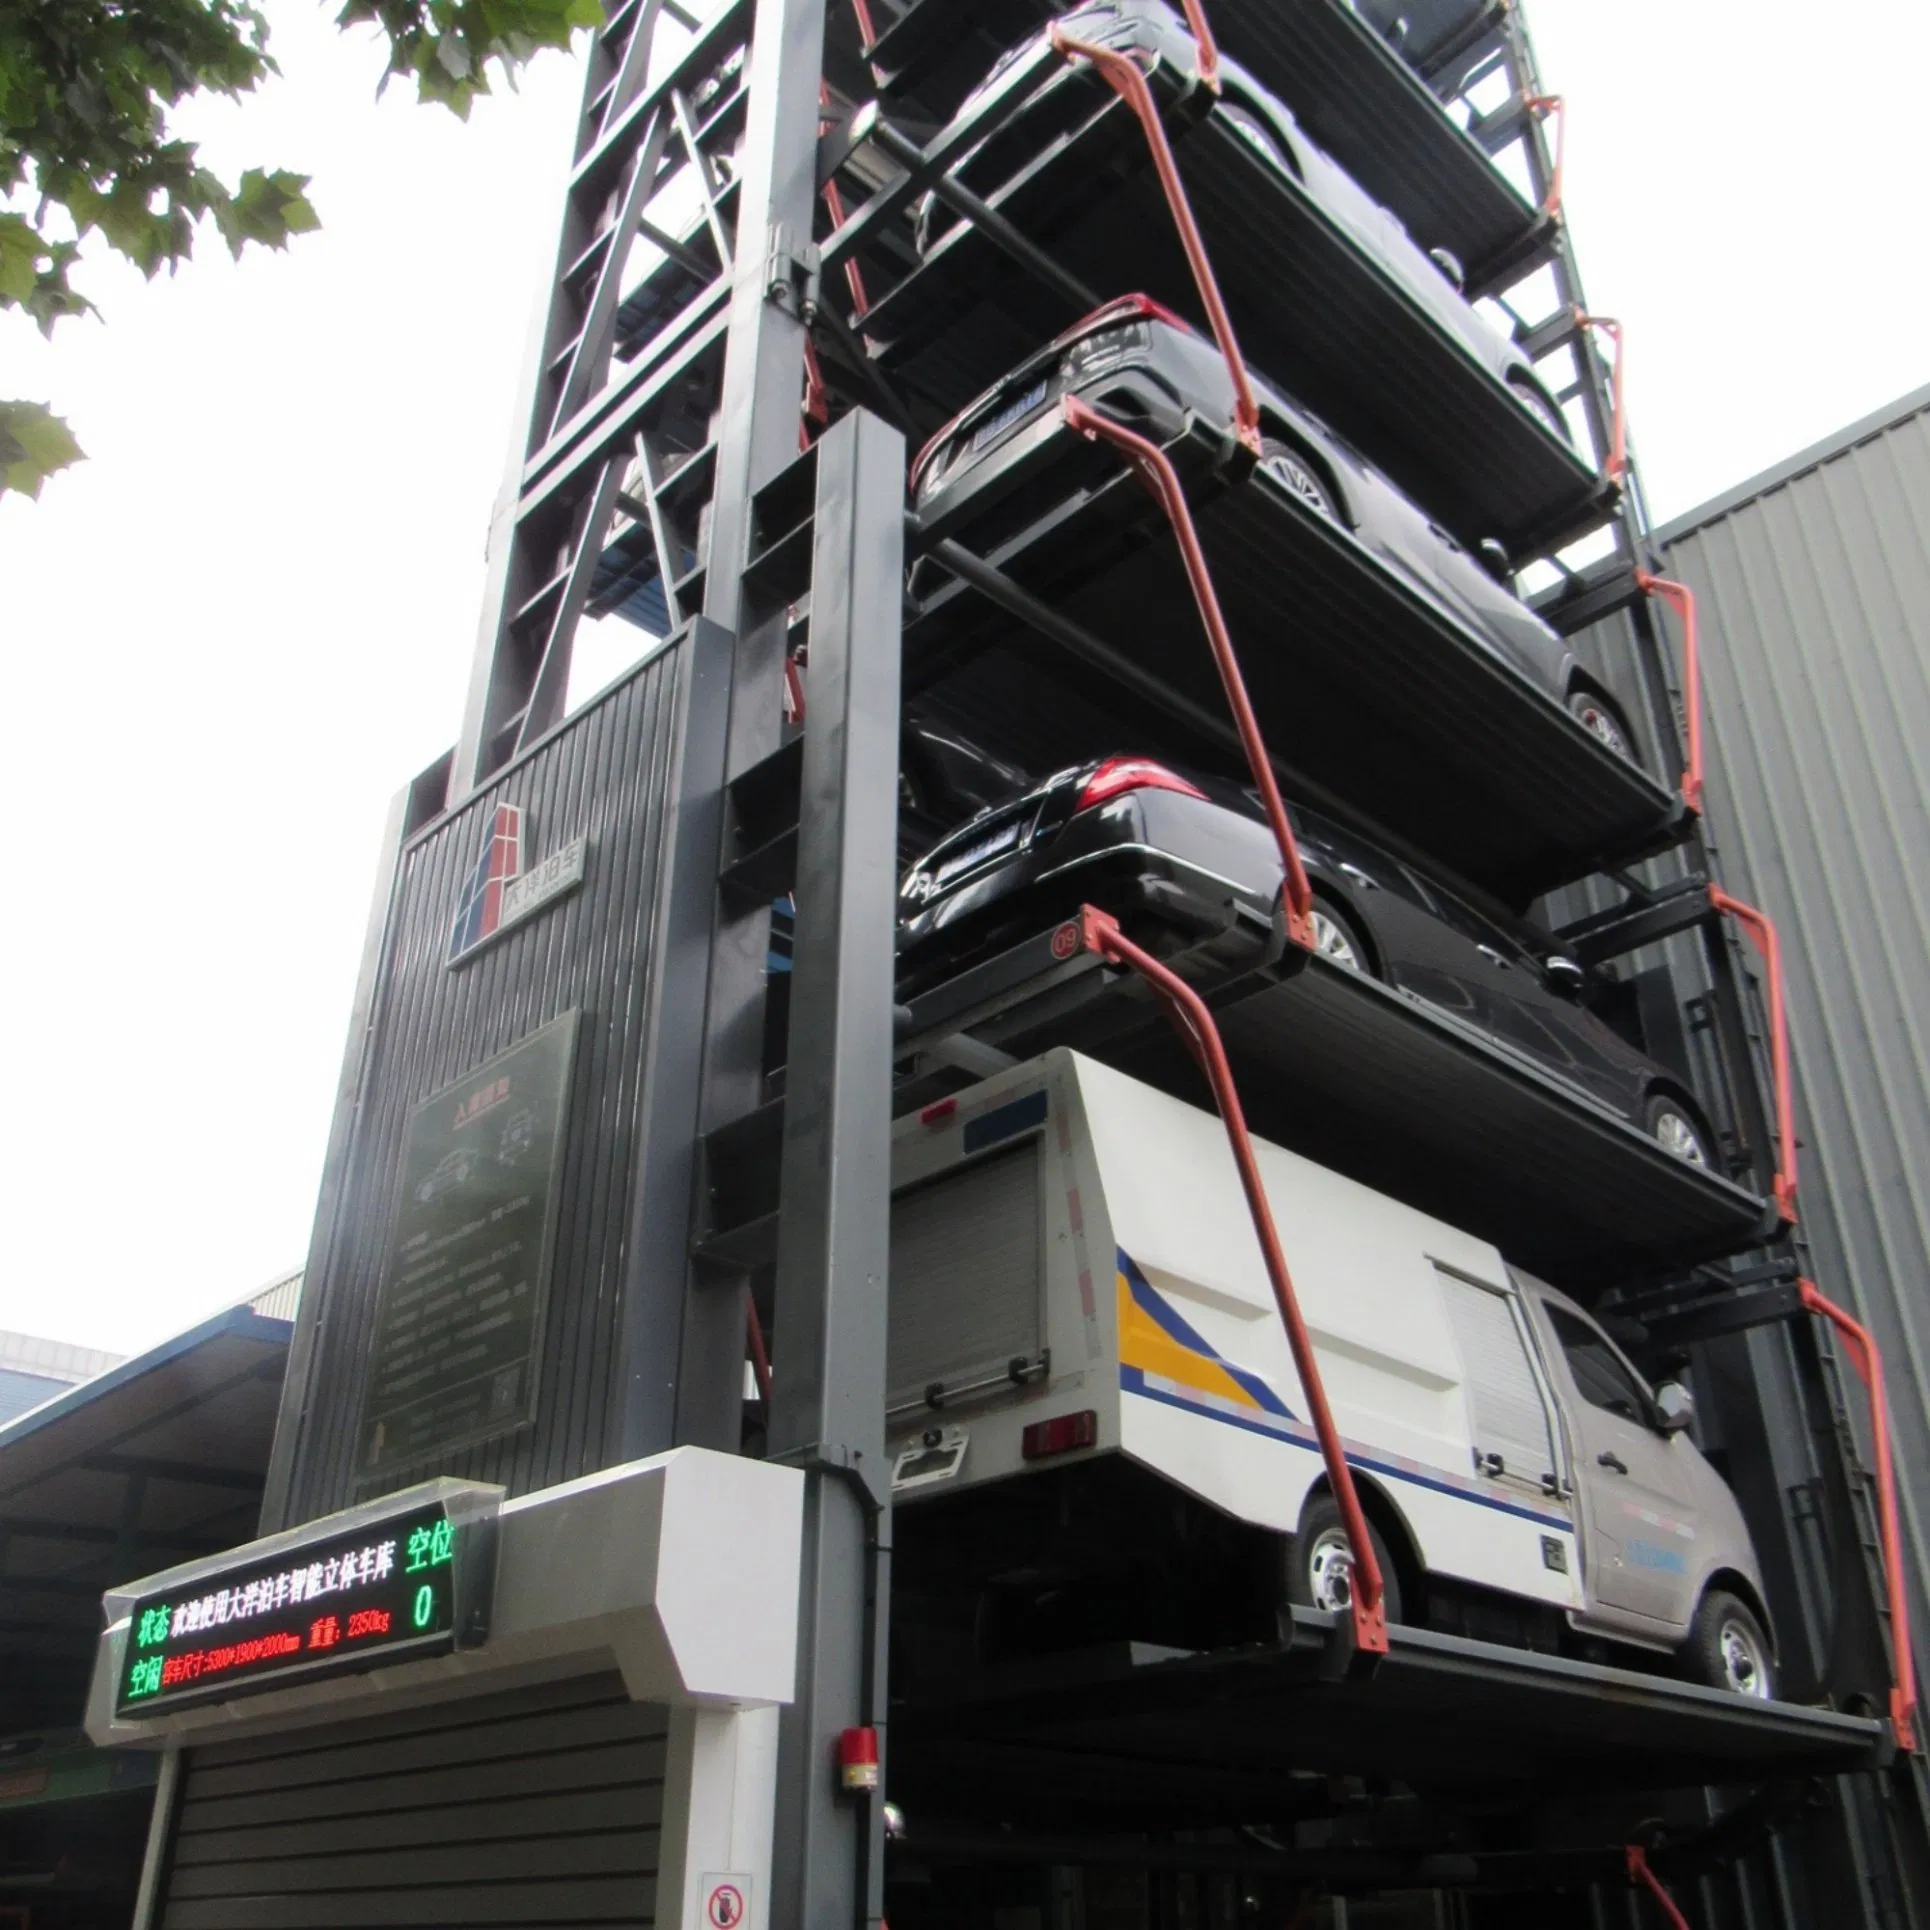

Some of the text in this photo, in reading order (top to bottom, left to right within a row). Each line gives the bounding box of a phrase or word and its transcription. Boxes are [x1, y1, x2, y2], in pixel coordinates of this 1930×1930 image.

[1055, 928, 1077, 952] 09
[405, 1519, 456, 1573] 空位
[170, 1540, 397, 1638] 欢迎使用大洋泊车智能立体车库
[414, 1585, 433, 1627] 0
[137, 1605, 172, 1648] 状态
[127, 1655, 164, 1698] 空闲
